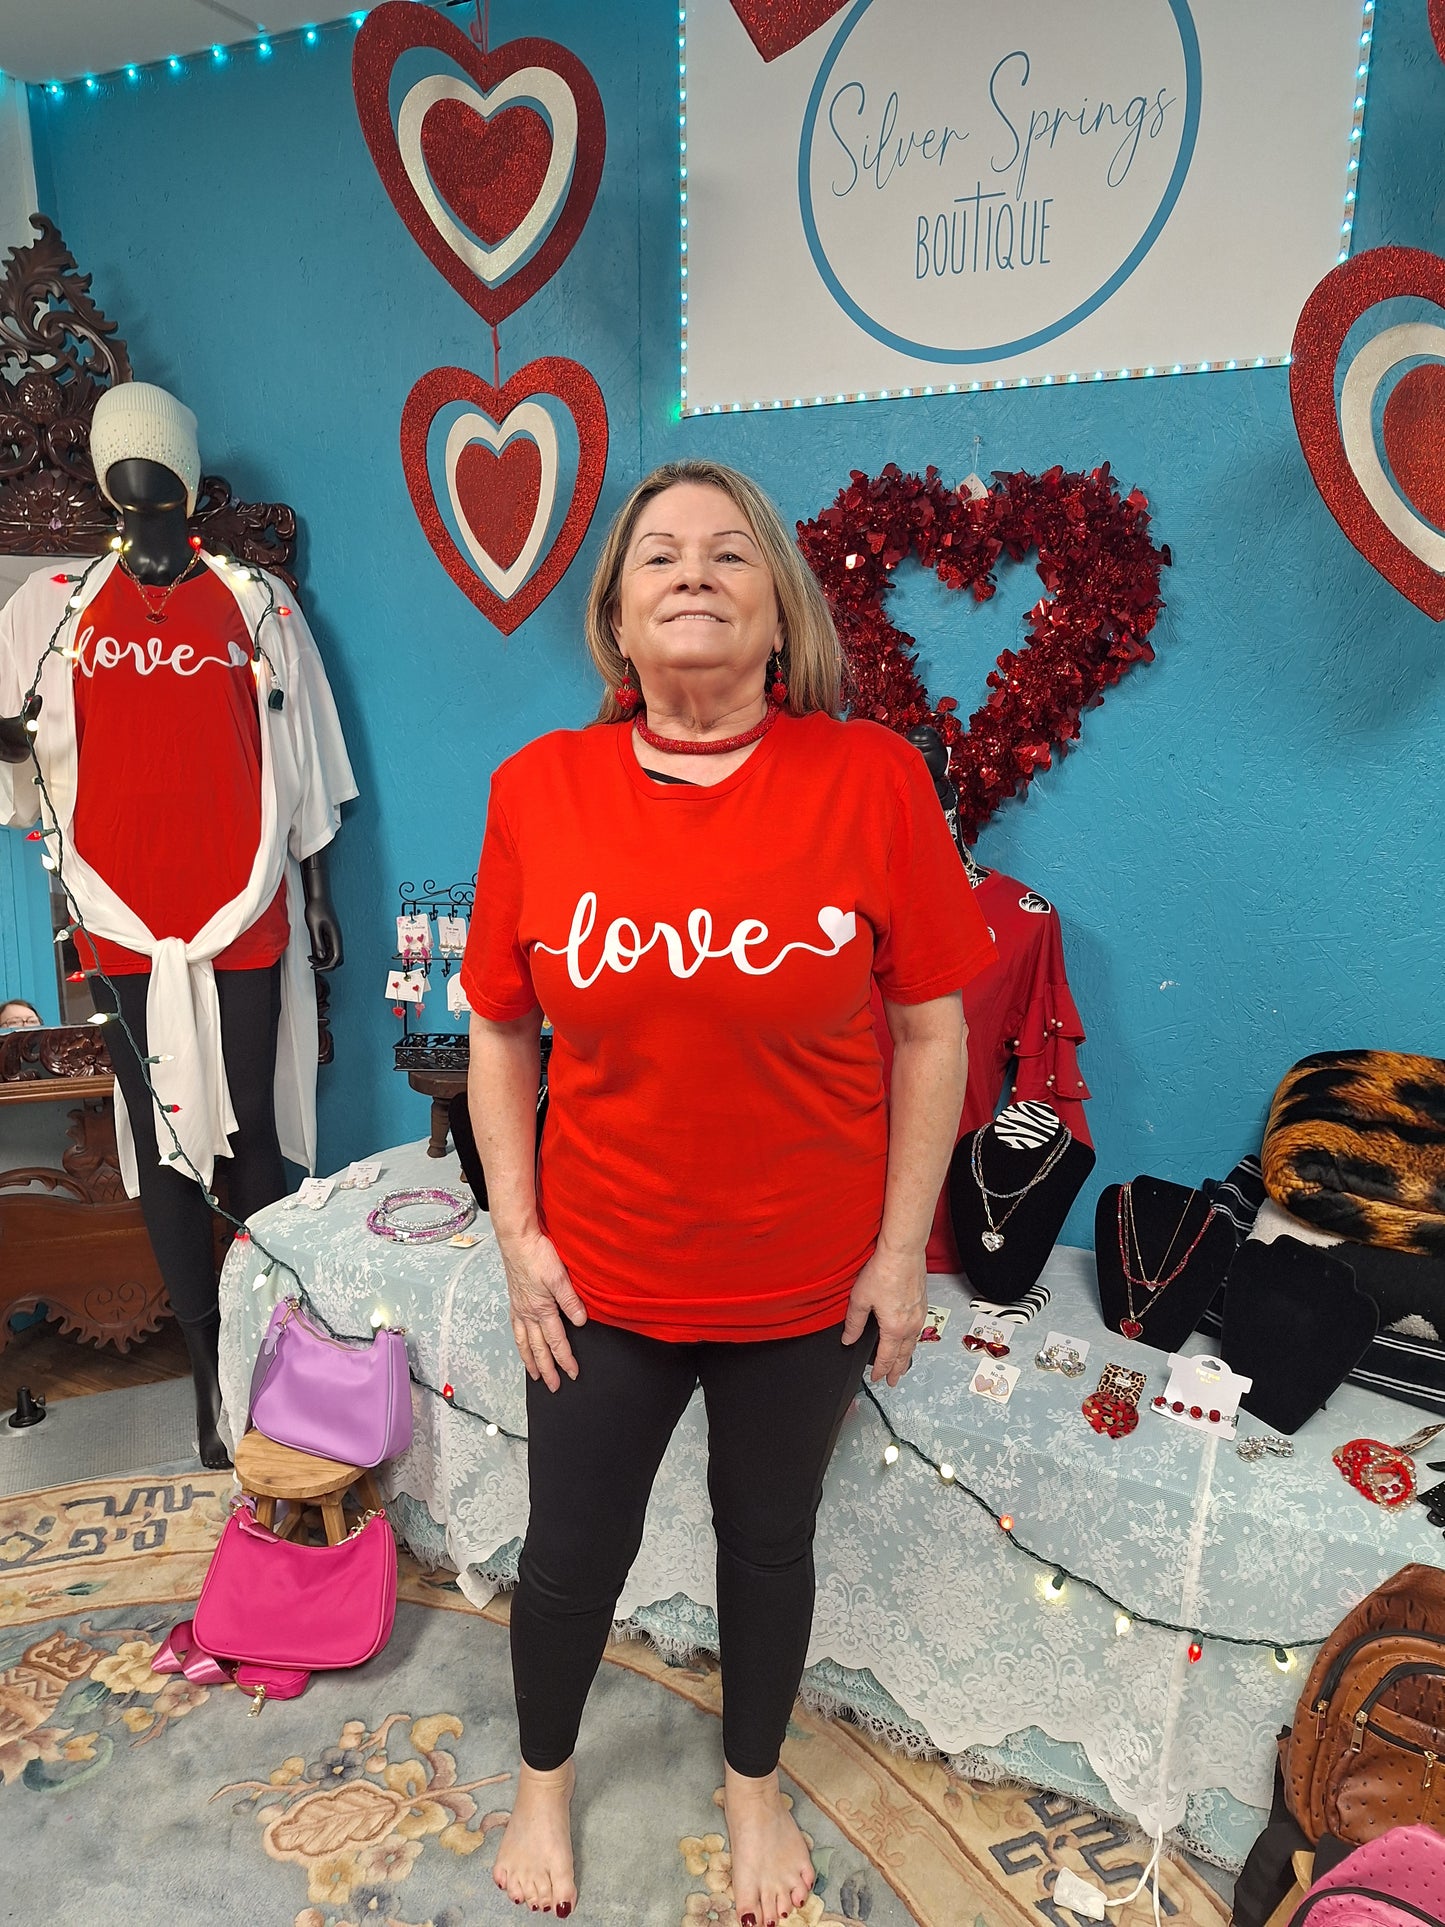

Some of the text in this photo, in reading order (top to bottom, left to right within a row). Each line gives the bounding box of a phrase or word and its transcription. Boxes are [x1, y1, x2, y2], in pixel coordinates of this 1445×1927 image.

[828, 50, 1177, 201] Silver Springs
[915, 181, 1054, 280] BOUTIQUE
[74, 625, 206, 679] love
[536, 891, 802, 989] love
